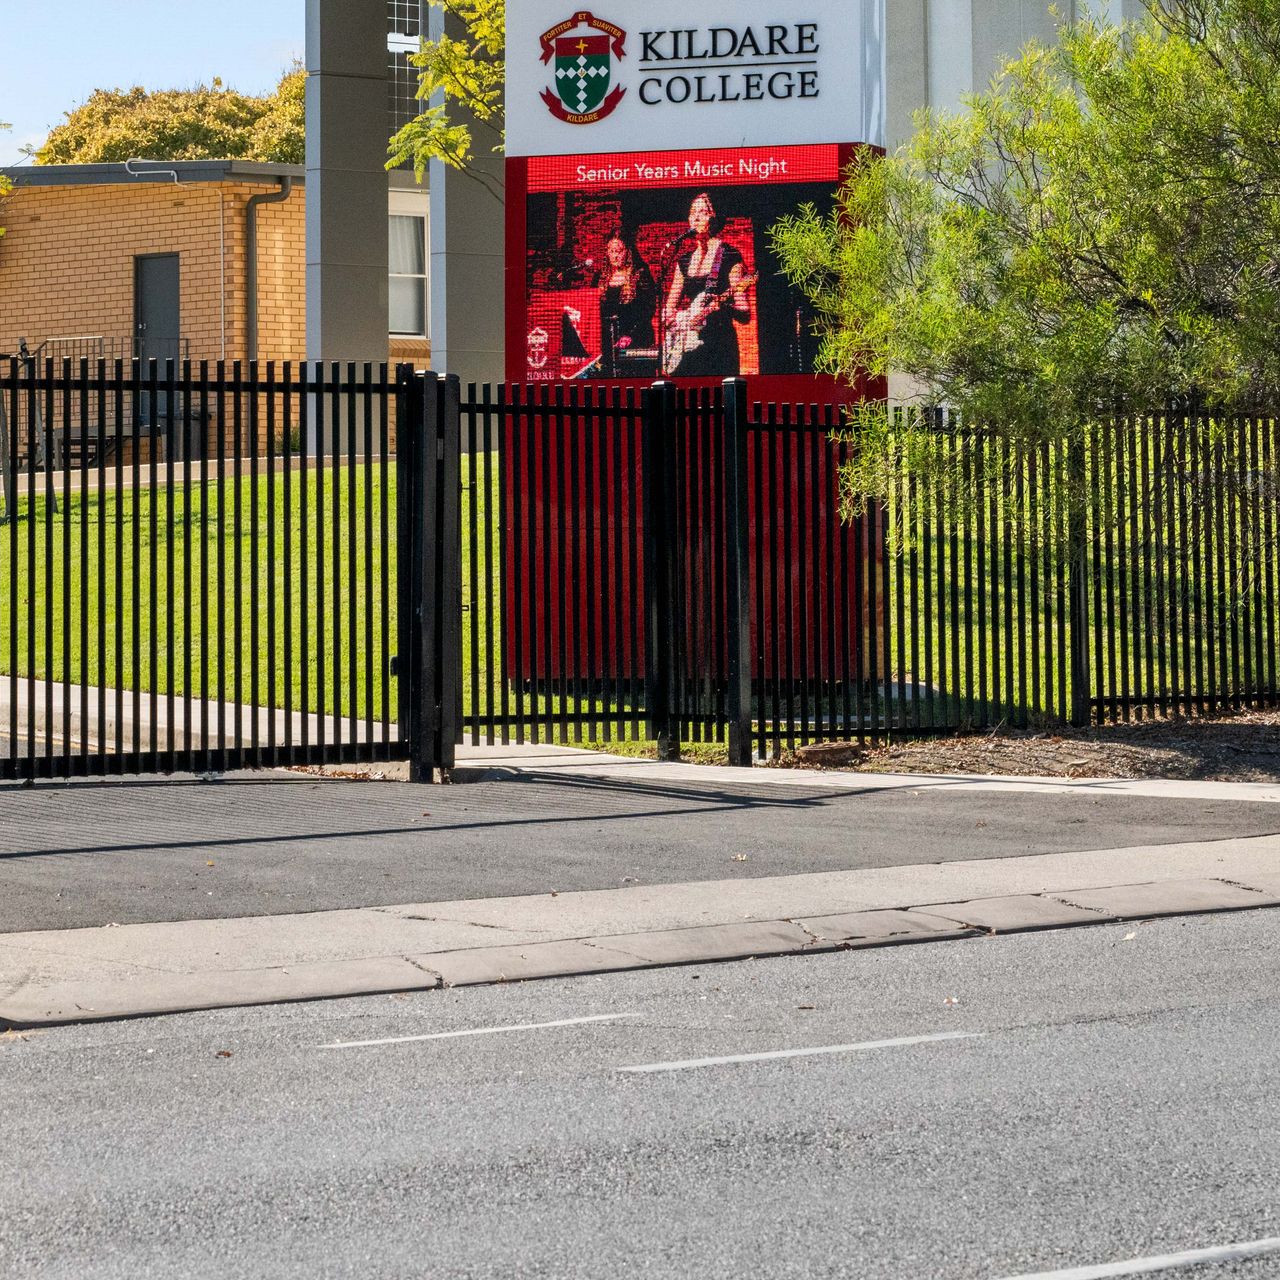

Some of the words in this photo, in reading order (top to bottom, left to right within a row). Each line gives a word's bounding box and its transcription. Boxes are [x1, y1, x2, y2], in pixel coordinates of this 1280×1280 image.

[543, 21, 573, 41] FORTITER
[592, 19, 622, 38] SUAVITER
[639, 23, 819, 61] KILDARE
[638, 71, 819, 105] COLLEGE
[566, 113, 599, 123] KILDARE
[576, 164, 630, 182] Senior
[634, 163, 679, 179] Years
[684, 160, 734, 178] Music
[738, 156, 788, 179] Night
